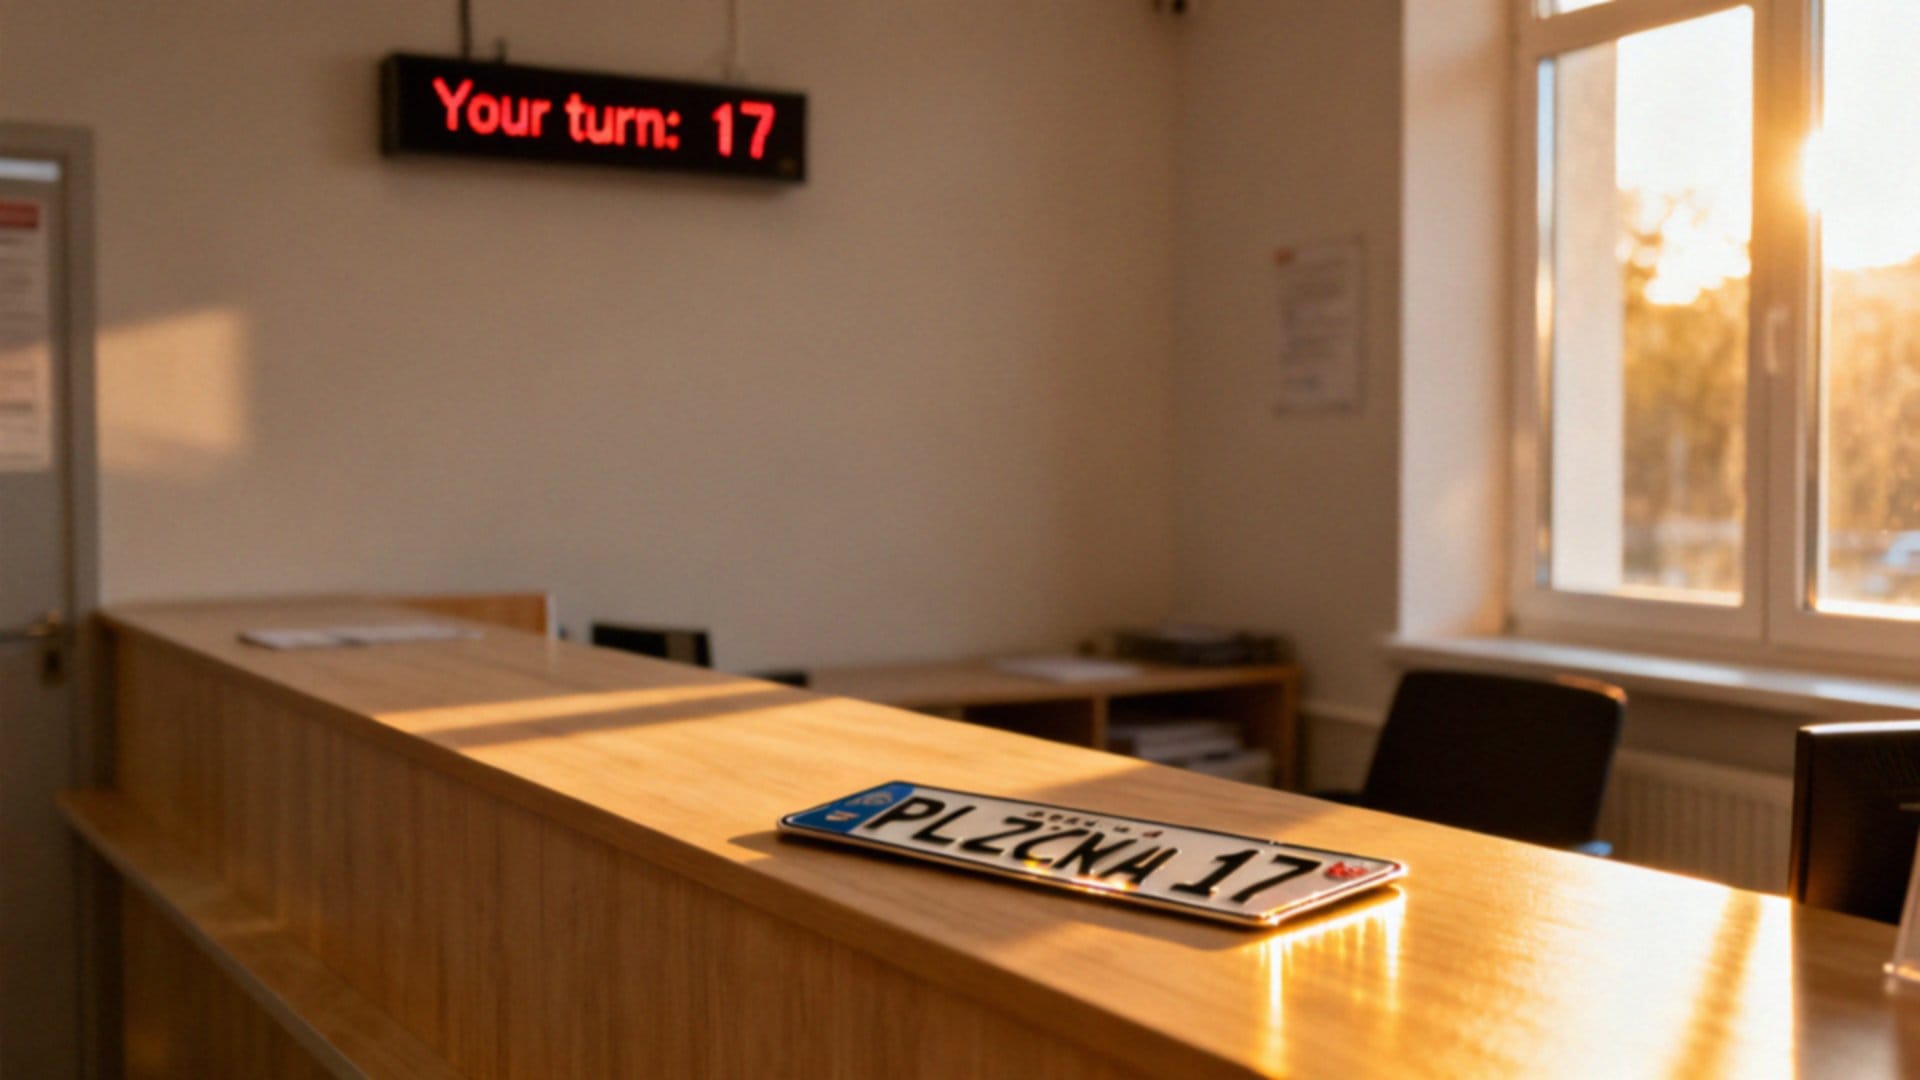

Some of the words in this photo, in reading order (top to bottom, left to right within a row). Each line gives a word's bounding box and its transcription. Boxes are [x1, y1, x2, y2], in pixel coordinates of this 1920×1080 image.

[433, 77, 551, 138] Your
[565, 93, 681, 150] turn:
[713, 102, 776, 159] 17
[1171, 850, 1320, 903] 17
